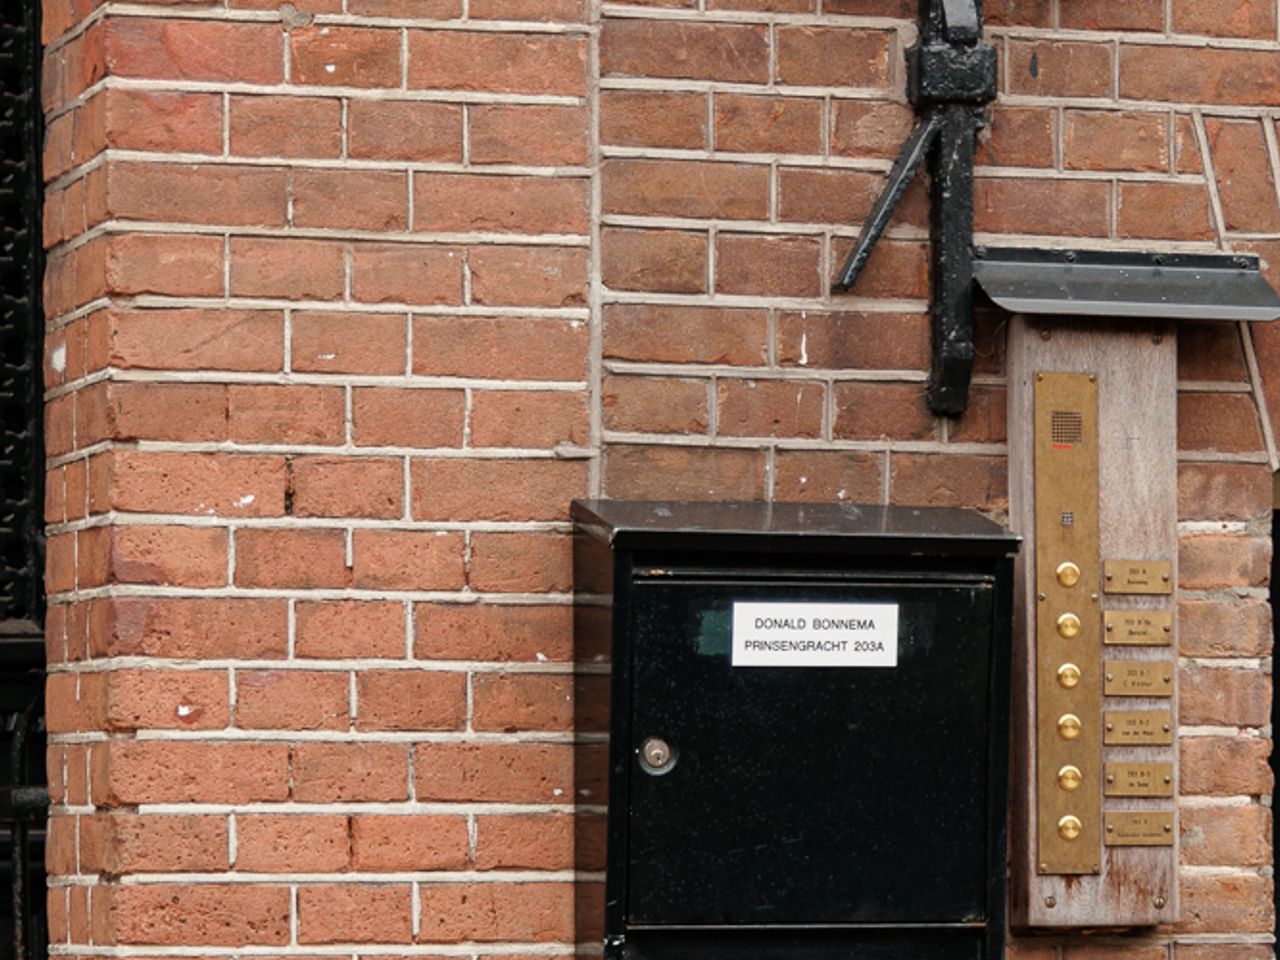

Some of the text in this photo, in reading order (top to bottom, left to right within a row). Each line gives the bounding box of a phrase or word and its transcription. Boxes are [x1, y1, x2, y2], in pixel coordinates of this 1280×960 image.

[754, 617, 875, 630] DONALD BONNEMA
[744, 640, 885, 652] PRINSENGRACHT 203A
